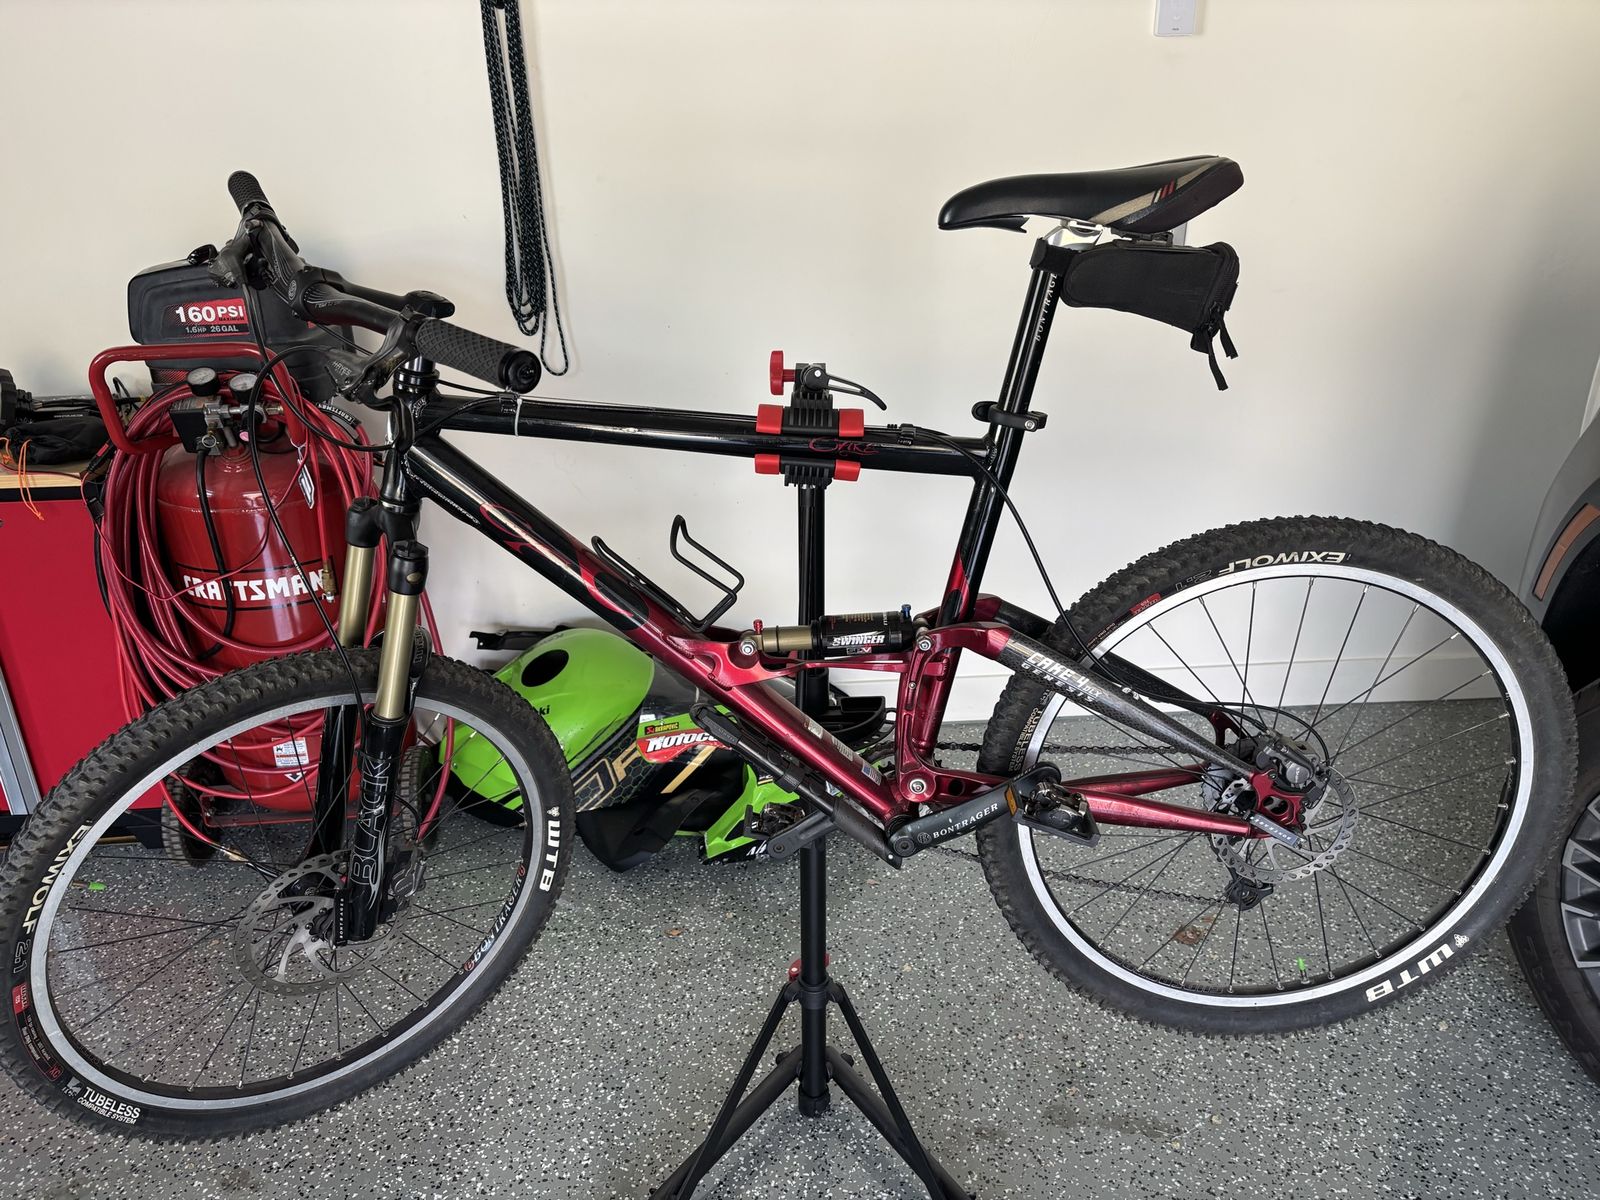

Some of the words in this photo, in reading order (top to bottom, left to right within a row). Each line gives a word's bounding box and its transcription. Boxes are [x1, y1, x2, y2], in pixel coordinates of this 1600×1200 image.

[1218, 551, 1346, 576] EXIWOLF
[184, 568, 324, 602] CRATSMAN
[831, 634, 886, 647] SWINGER
[1021, 661, 1094, 702] GENESIS
[1027, 652, 1075, 681] CAKE
[1014, 710, 1043, 771] TUBELESS
[350, 754, 392, 886] BLACK
[933, 803, 998, 839] BONTRAGER
[539, 820, 561, 892] WTB
[22, 824, 92, 935] EXIWOLF
[473, 874, 523, 963] BONTRAGER
[1365, 943, 1455, 1003] WTB
[77, 1096, 112, 1118] COMPATIBLE
[110, 1113, 137, 1125] SYSTEM
[83, 1086, 141, 1119] TUBELESS
